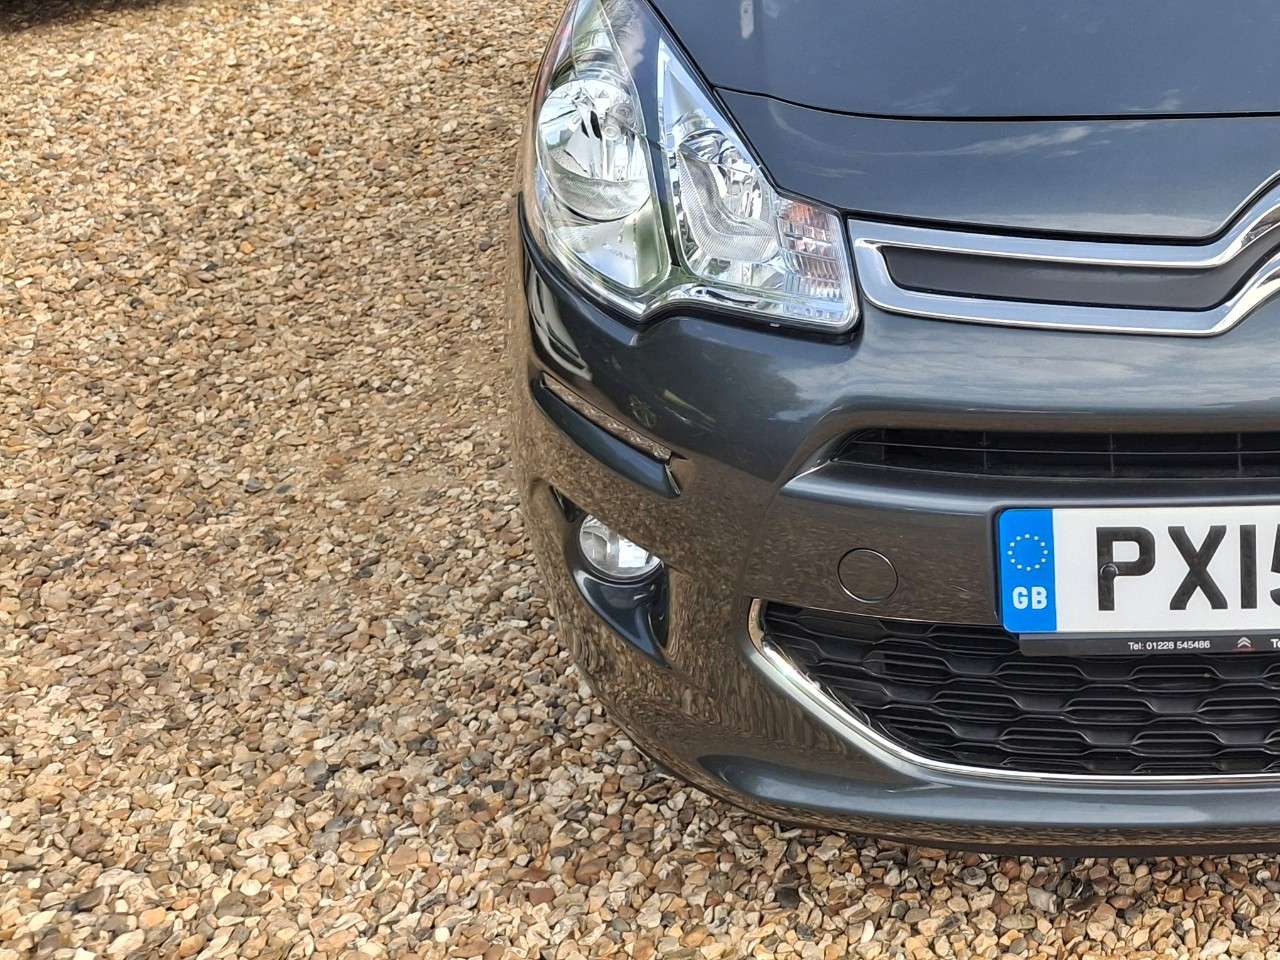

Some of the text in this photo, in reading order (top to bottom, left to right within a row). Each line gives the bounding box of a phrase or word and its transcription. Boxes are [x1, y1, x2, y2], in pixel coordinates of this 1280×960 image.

[1012, 586, 1048, 610] GB
[1128, 641, 1145, 650] Tel:
[1146, 641, 1174, 650] 01228
